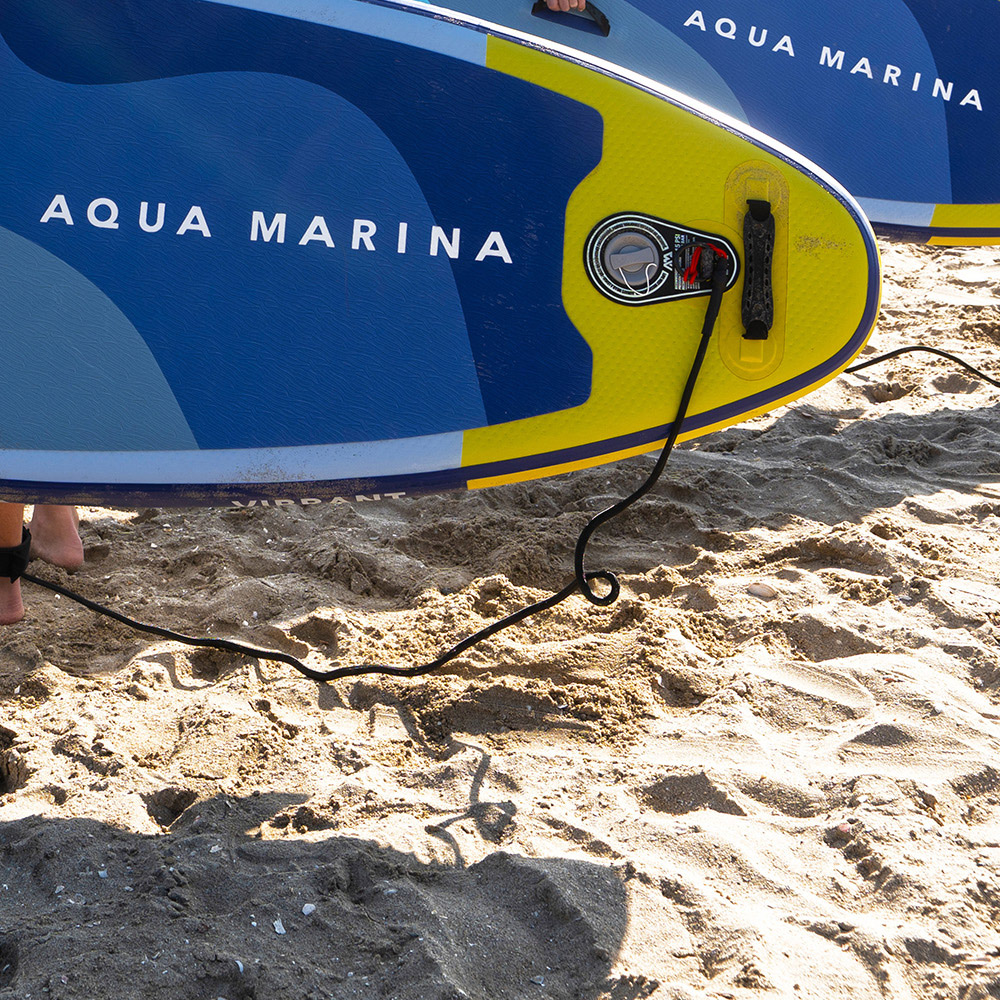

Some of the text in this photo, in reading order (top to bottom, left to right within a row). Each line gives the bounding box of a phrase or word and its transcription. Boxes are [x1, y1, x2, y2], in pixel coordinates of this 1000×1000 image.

[683, 9, 984, 111] AQUA MARINA
[40, 194, 513, 264] AQUA MARINA
